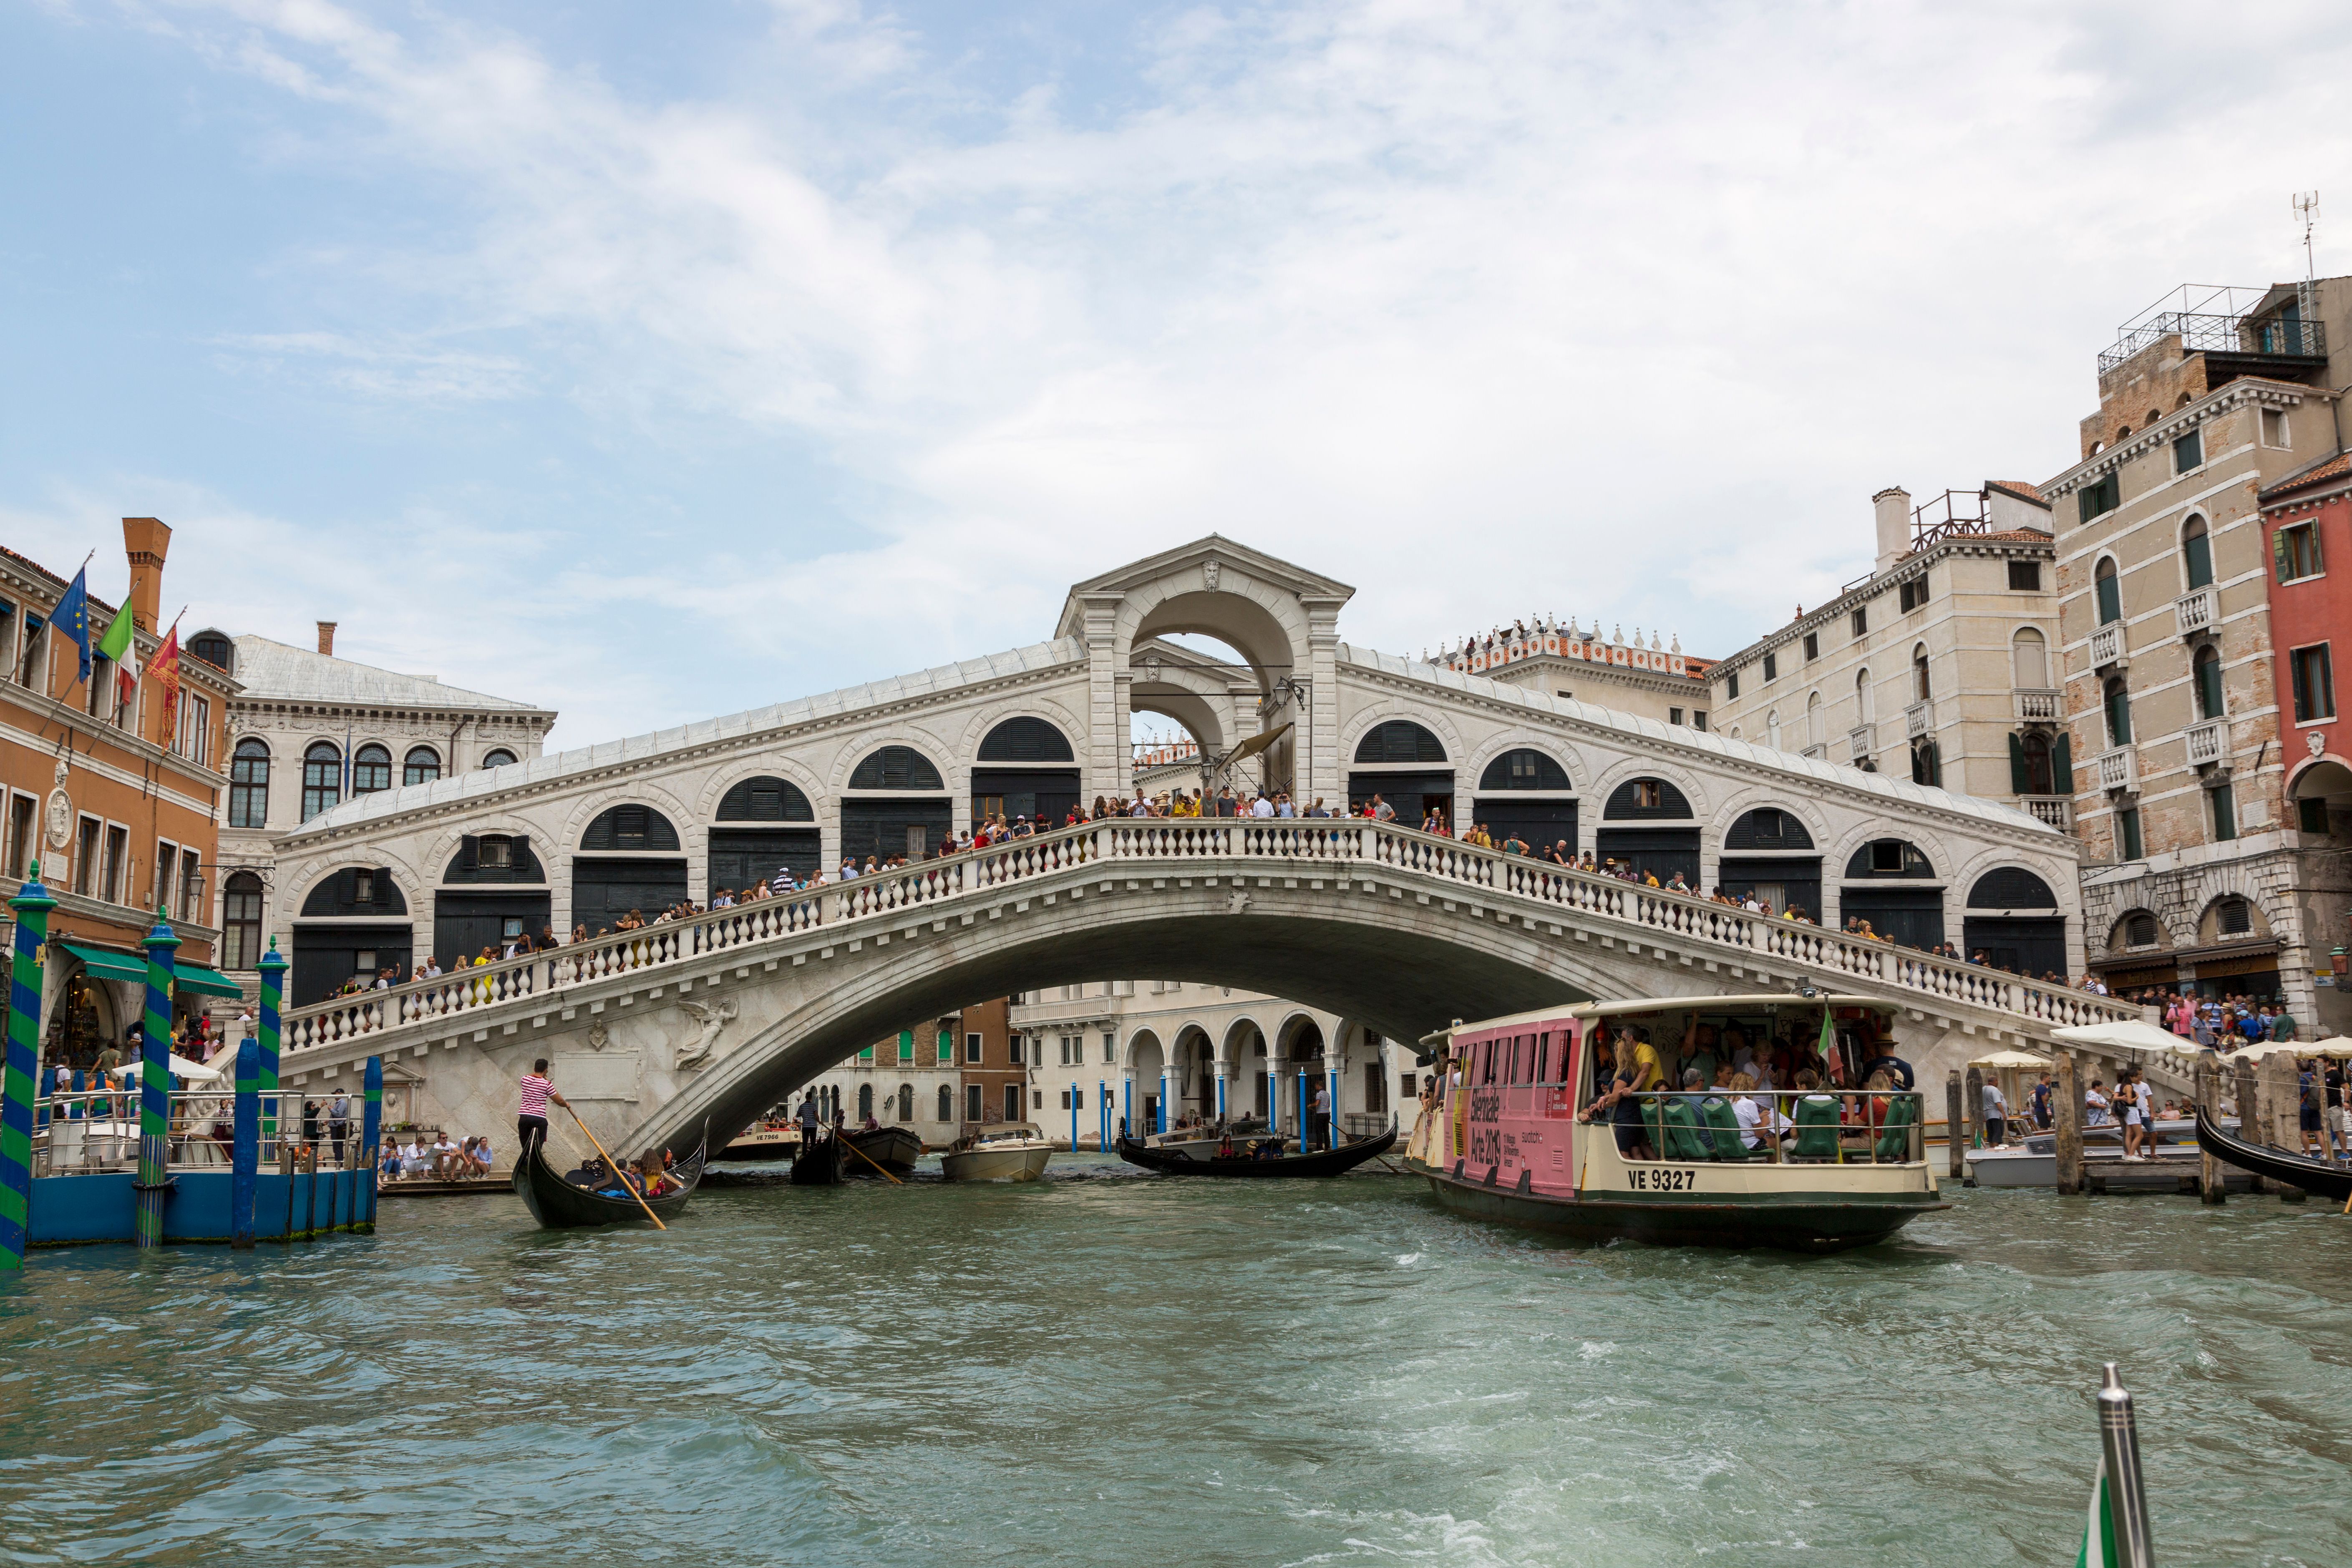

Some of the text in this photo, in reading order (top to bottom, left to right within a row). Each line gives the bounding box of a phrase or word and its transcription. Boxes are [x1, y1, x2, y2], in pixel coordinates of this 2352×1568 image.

[2128, 973, 2140, 982] Hard
[1471, 1087, 1499, 1123] Biennale
[1471, 1128, 1484, 1163] Arte
[1486, 1128, 1501, 1166] 2019
[1522, 1130, 1539, 1143] swatch
[1628, 1169, 1695, 1191] VE 9327
